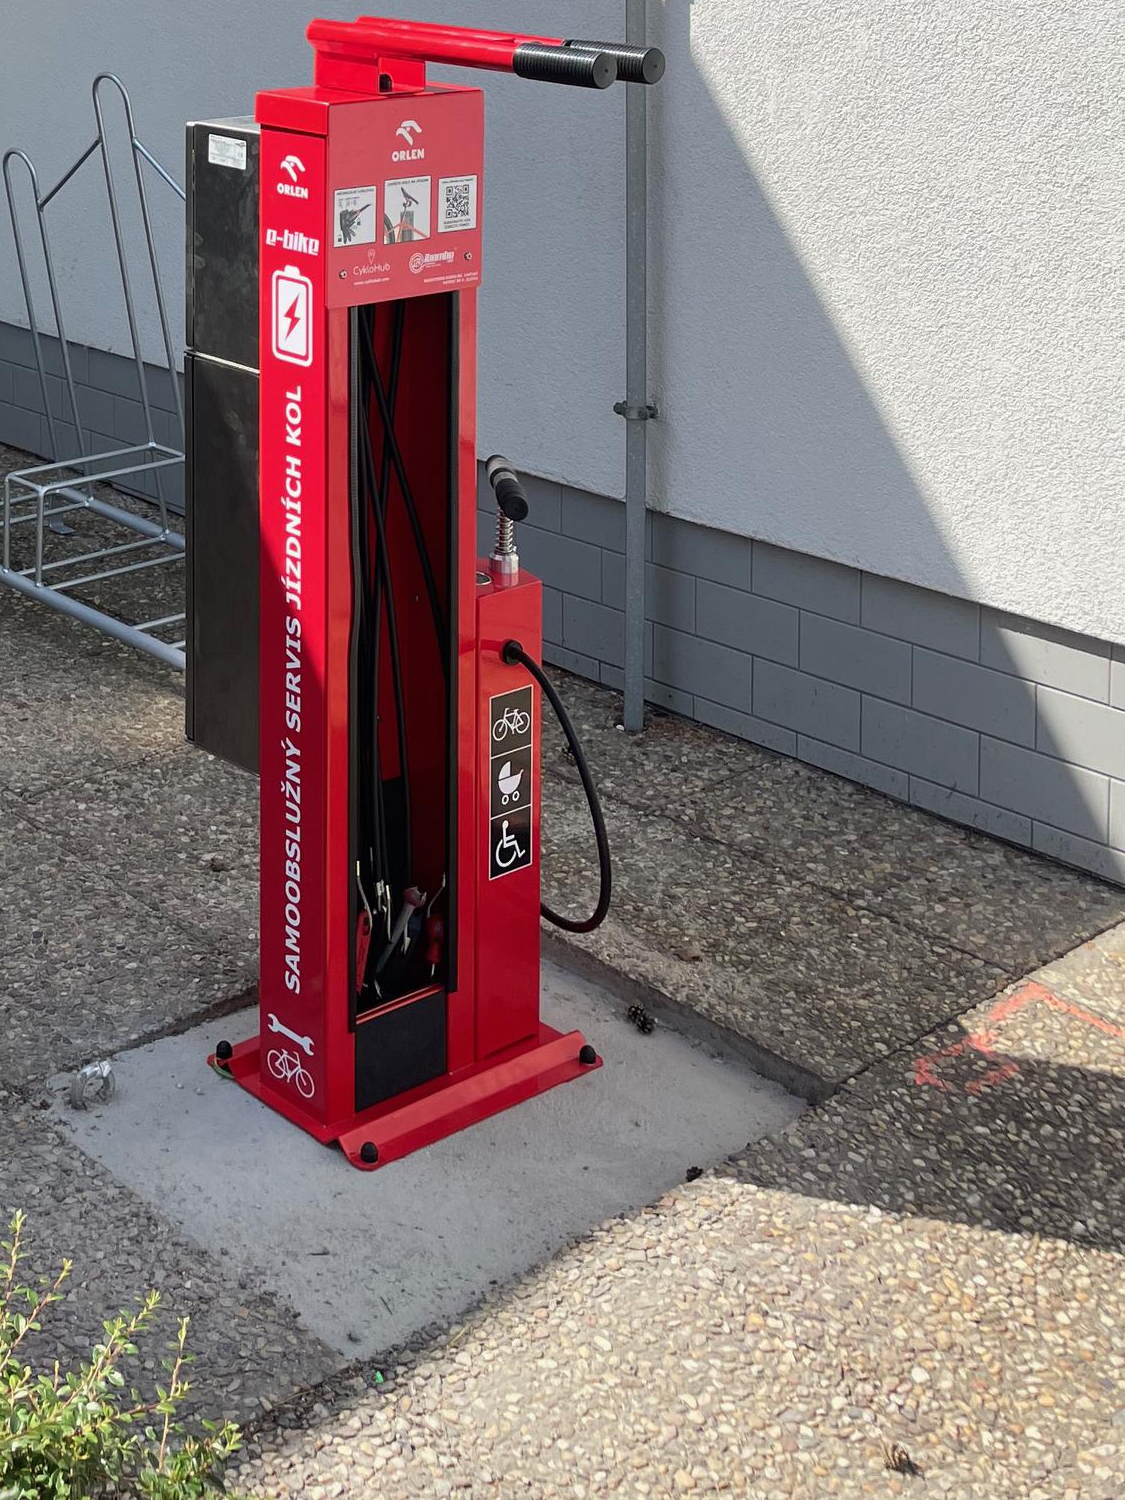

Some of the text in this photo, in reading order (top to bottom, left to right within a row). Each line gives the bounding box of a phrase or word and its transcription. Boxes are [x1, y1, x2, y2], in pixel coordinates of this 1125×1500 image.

[391, 148, 425, 162] ORLEN
[276, 182, 309, 200] ORLEN
[265, 228, 320, 257] e-bike
[353, 262, 391, 277] CykloHub
[280, 385, 302, 995] SAMOOBSLUŽNÝ SERVIS JÍZDNÍCH KOL
